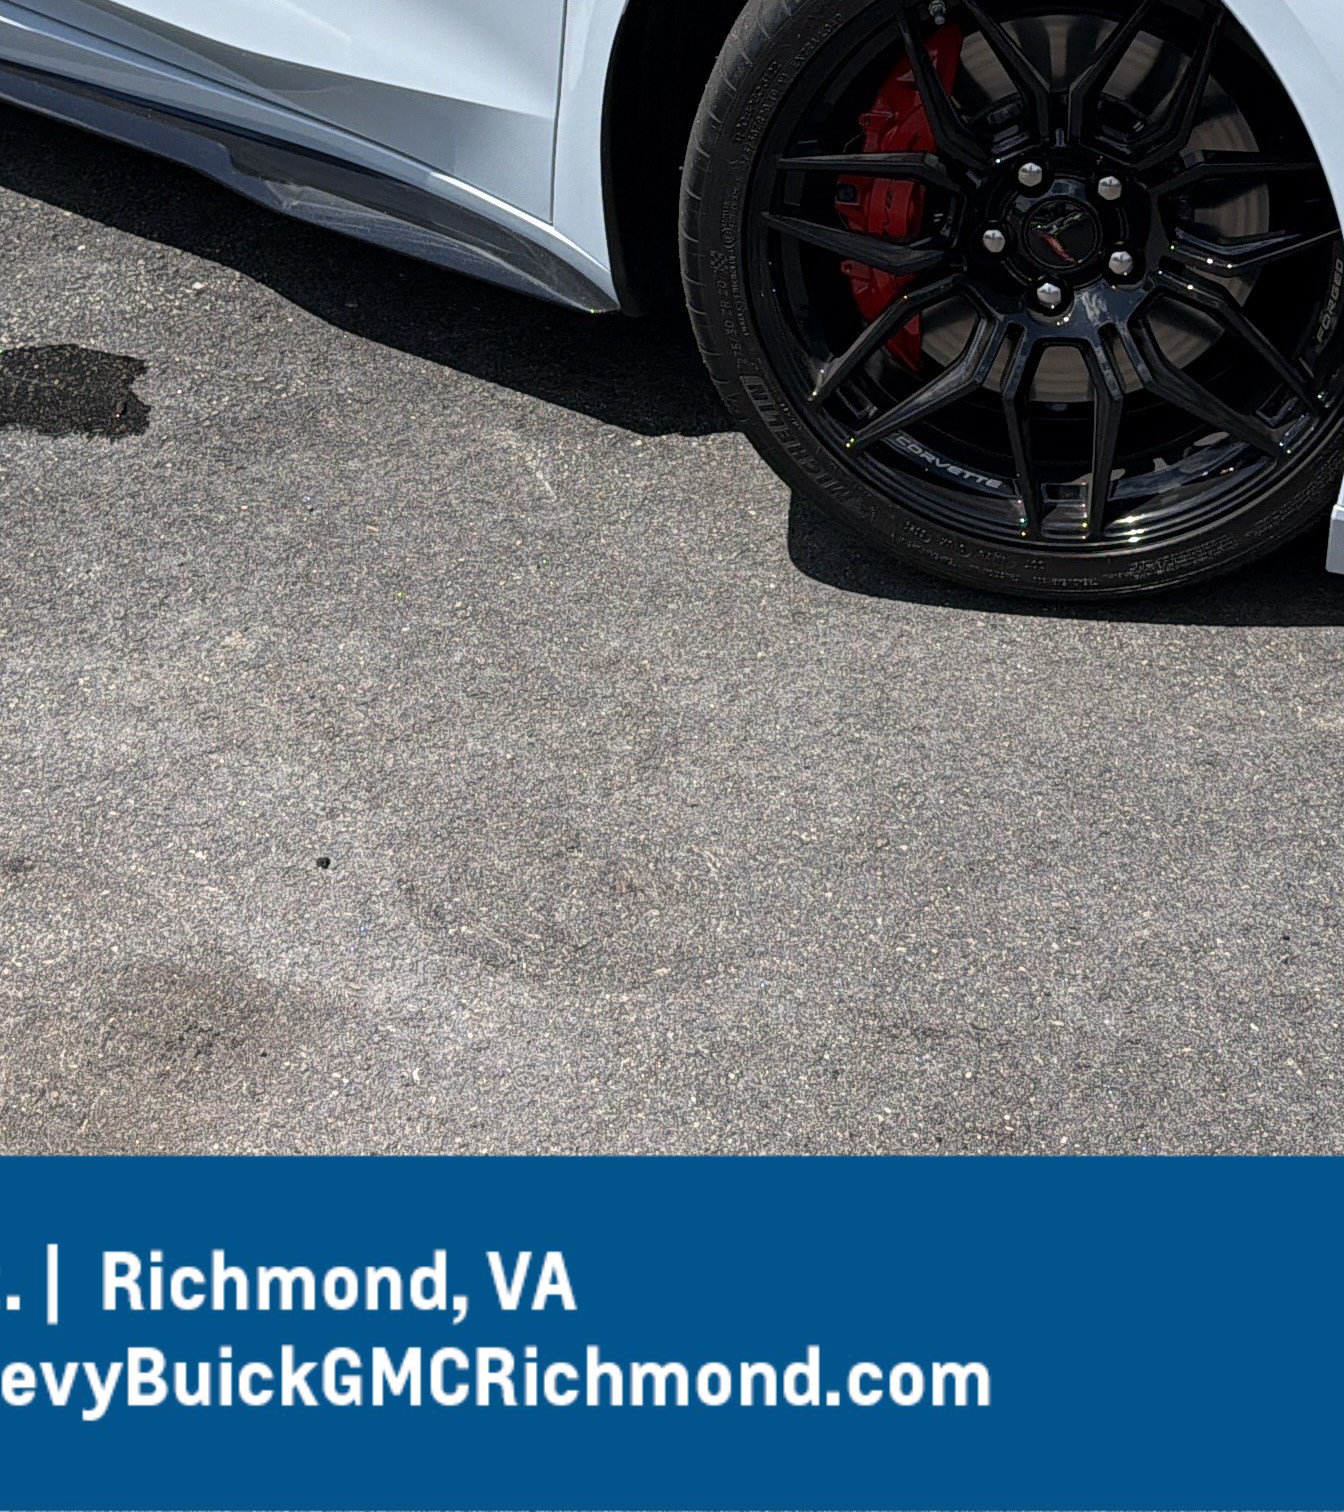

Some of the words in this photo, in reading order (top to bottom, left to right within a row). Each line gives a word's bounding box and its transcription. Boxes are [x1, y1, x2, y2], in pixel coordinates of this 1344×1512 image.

[1316, 258, 1344, 343] FORGED
[724, 319, 747, 369] 275/30
[742, 380, 852, 503] MICHELIN
[895, 435, 1003, 489] CORVETTE
